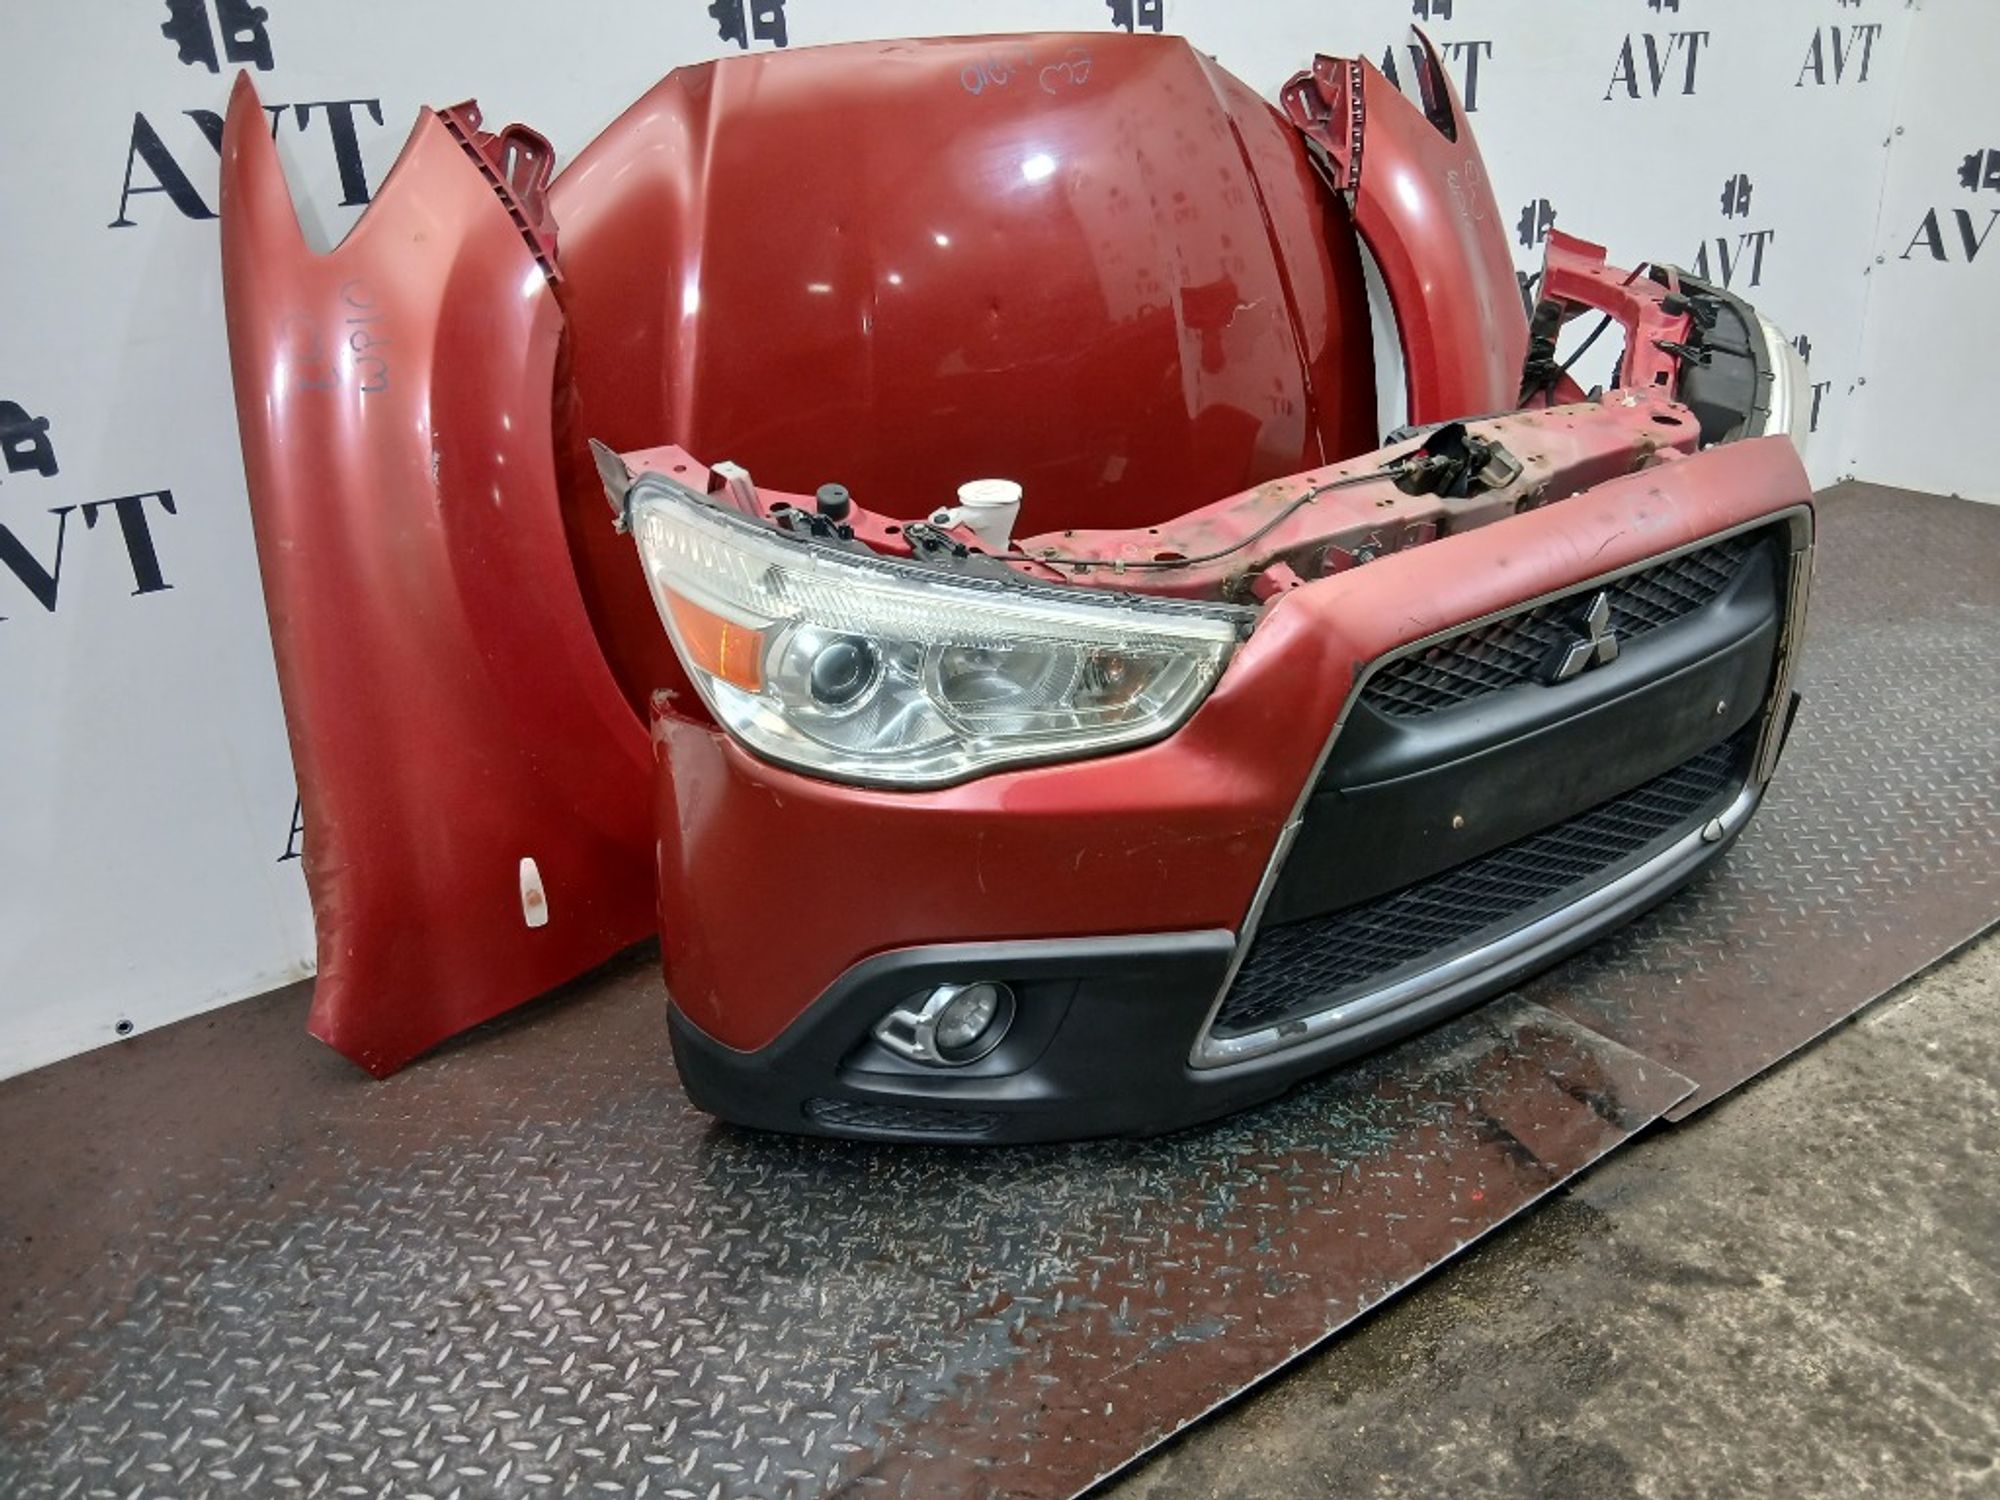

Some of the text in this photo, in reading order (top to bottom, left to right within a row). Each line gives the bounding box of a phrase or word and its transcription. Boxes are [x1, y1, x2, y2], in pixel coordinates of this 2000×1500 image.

[1603, 31, 1709, 100] AVT
[1795, 23, 1882, 87] AVT
[1691, 229, 1774, 290] AVT
[0, 489, 177, 622] VT
